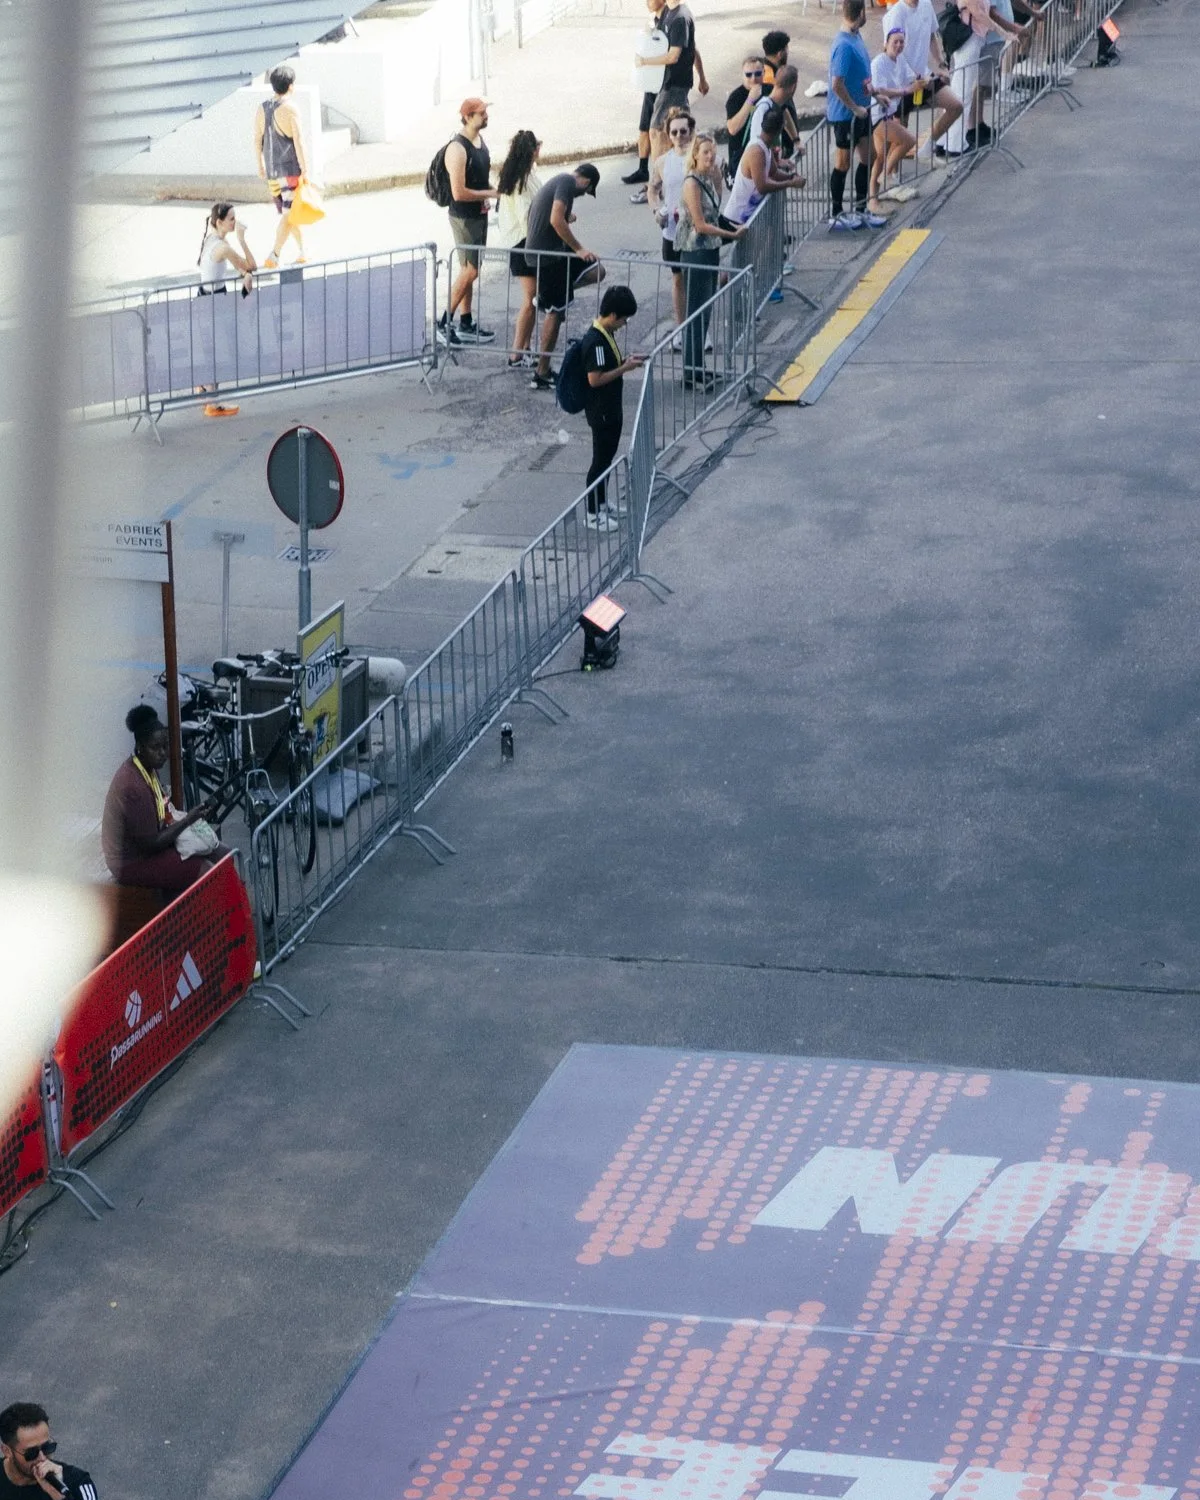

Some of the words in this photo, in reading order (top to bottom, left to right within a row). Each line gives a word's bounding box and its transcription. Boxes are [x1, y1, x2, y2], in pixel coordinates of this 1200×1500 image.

[108, 523, 161, 536] FABRIEK
[116, 536, 163, 548] EVENTS
[753, 1146, 1200, 1260] UN
